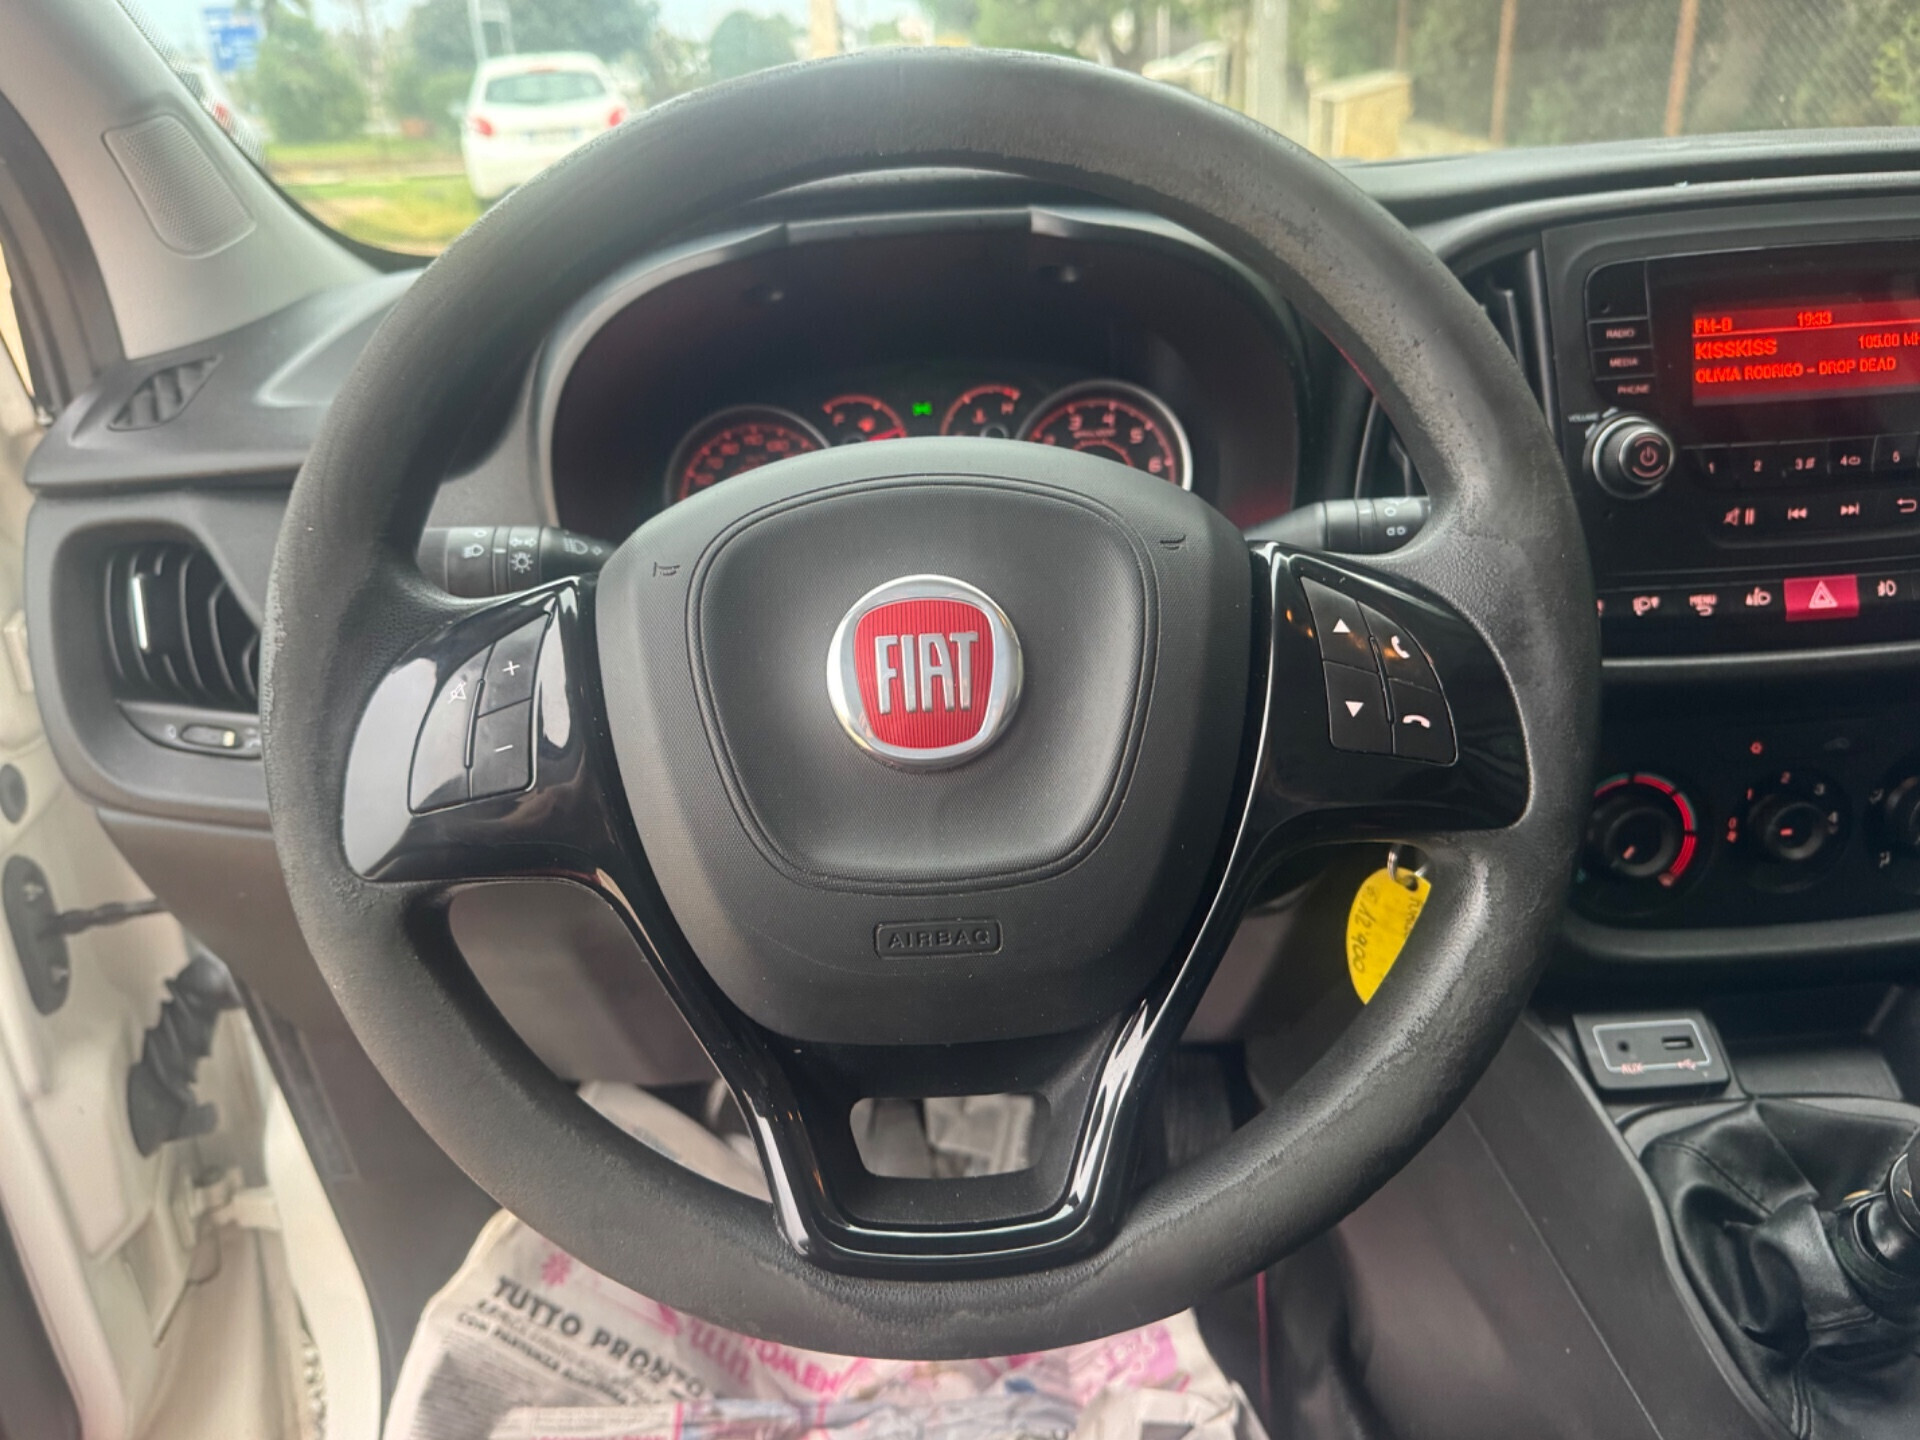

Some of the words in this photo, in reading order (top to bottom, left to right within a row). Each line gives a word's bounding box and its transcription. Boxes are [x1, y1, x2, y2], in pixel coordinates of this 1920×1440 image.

[1695, 338, 1777, 360] KISSKISS
[1695, 366, 1741, 383] OLIVIA
[1744, 362, 1804, 380] RODRIGO
[1819, 358, 1856, 375] DROP
[1859, 356, 1897, 372] DEAD
[874, 632, 979, 715] FIAT
[888, 928, 991, 949] AIRBAG
[493, 1276, 582, 1338] TUTTO
[590, 1325, 705, 1398] PRONTO
